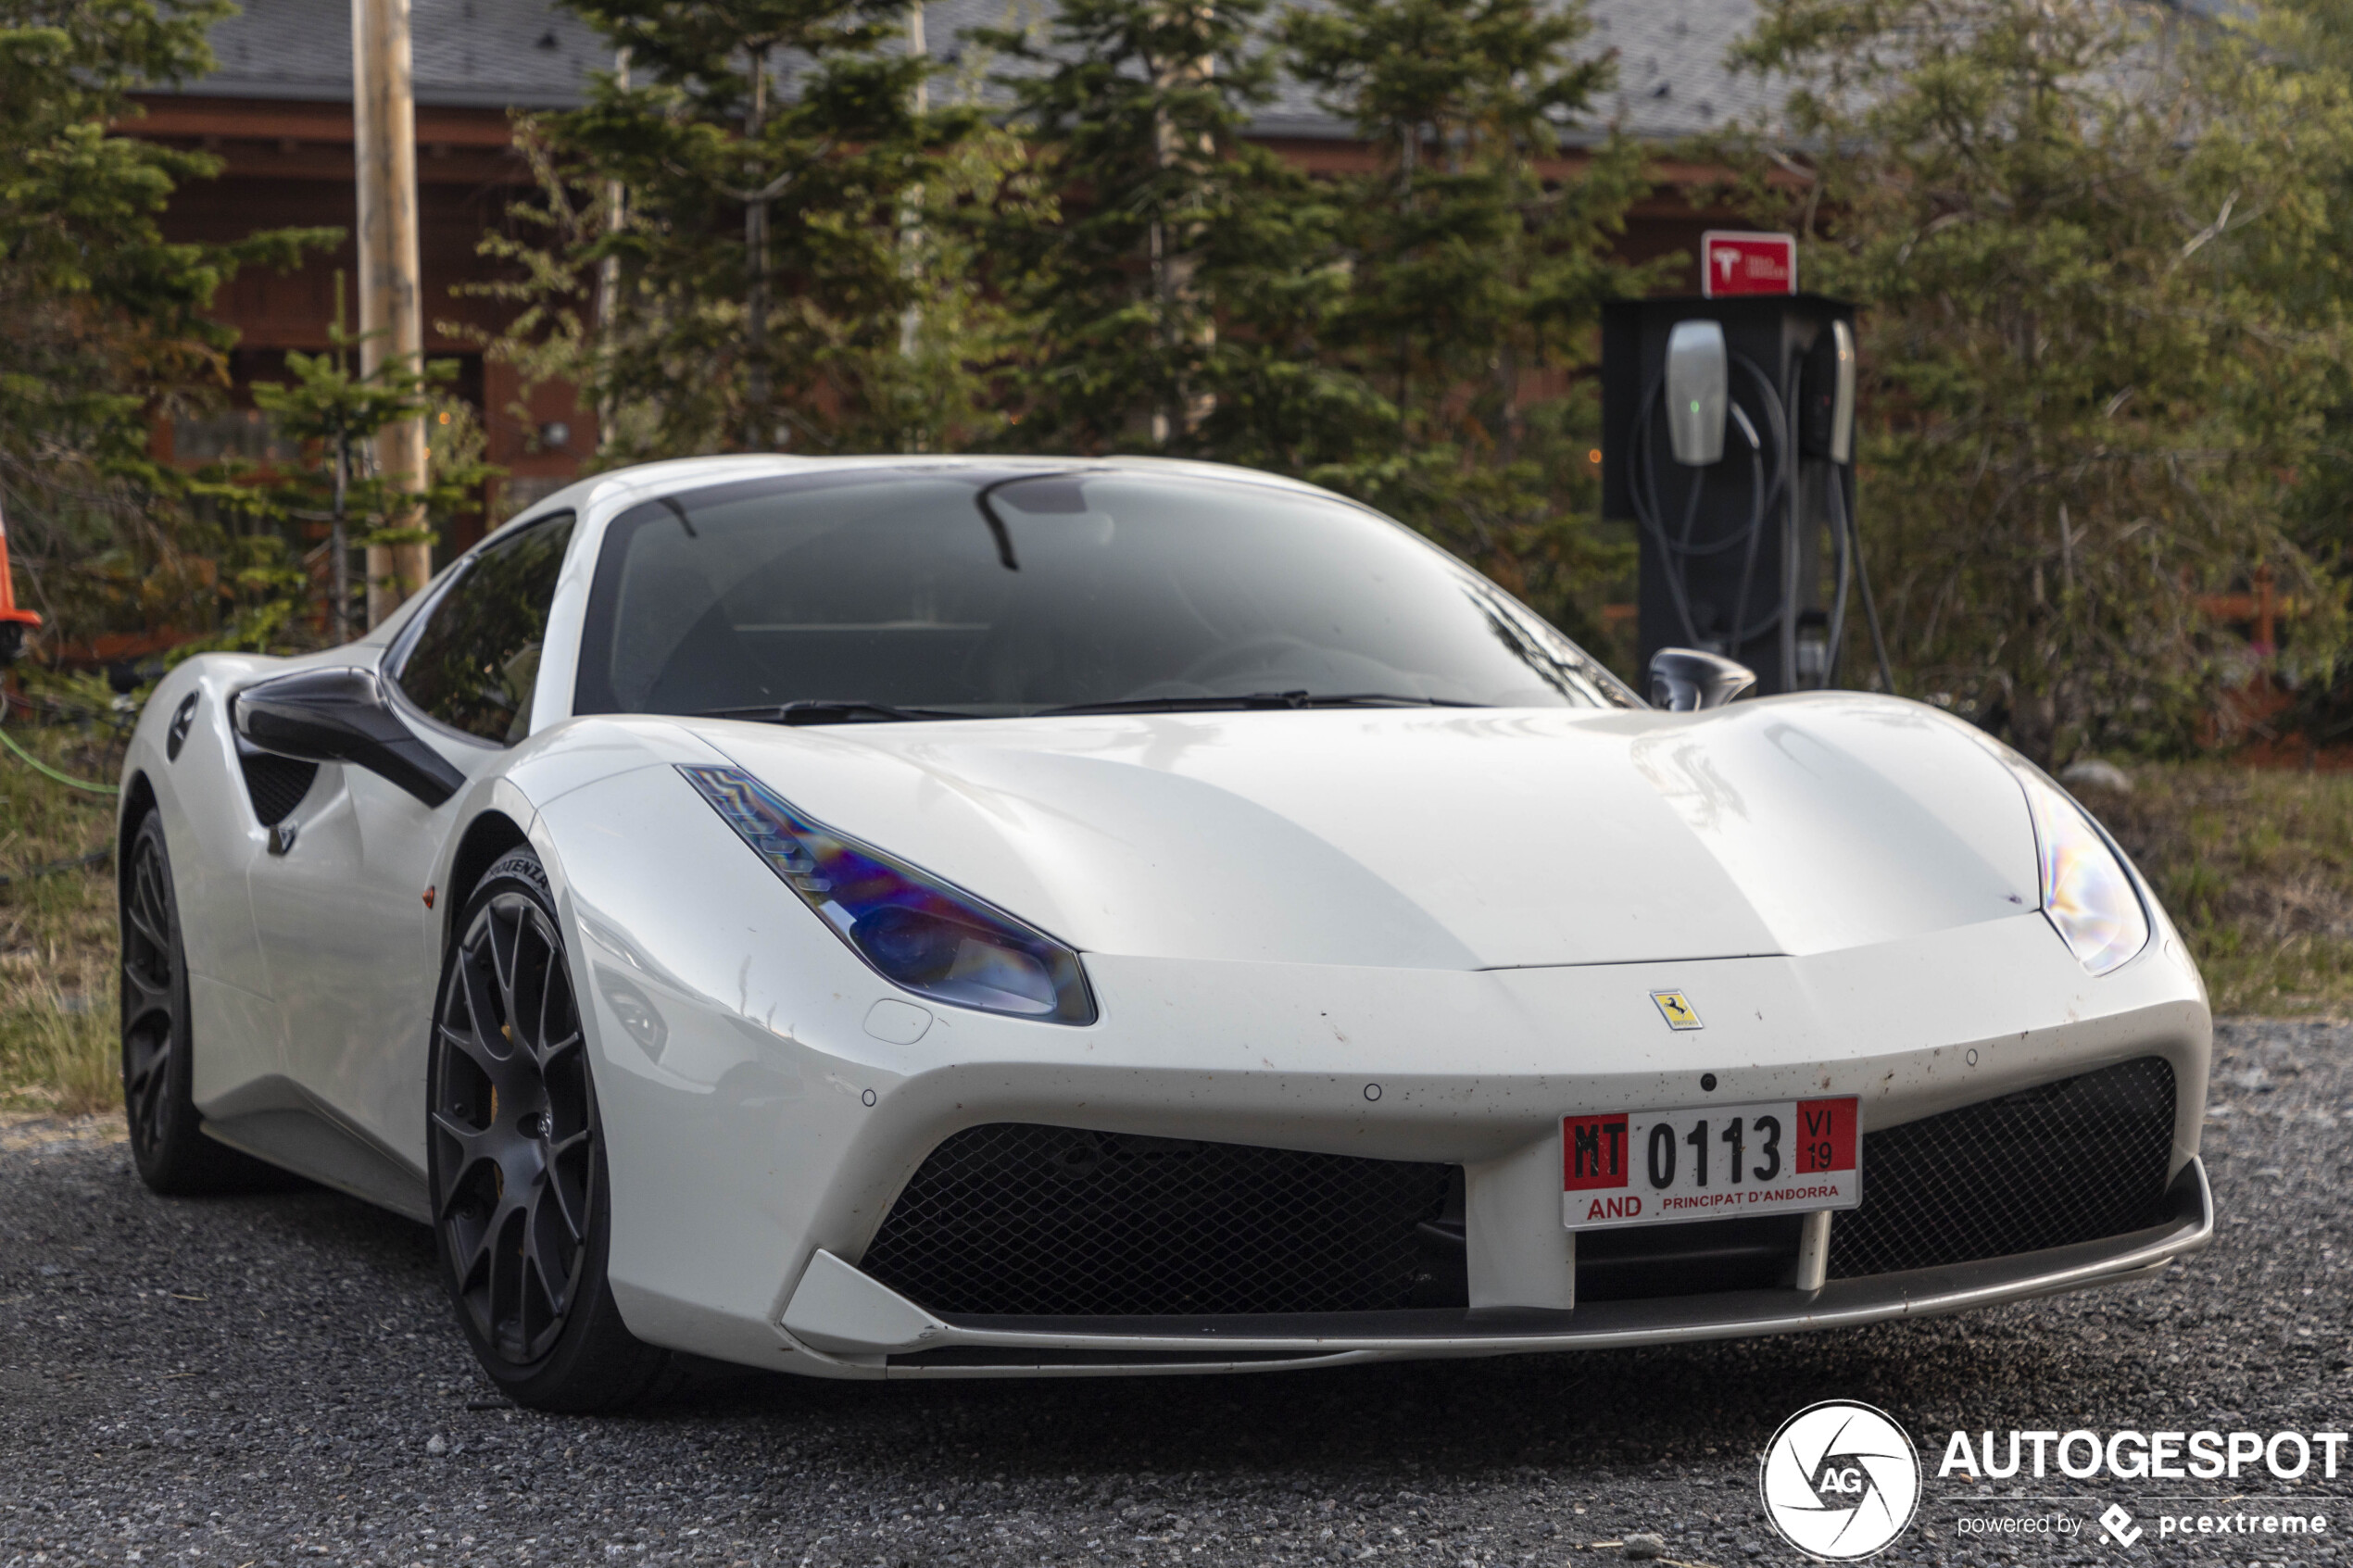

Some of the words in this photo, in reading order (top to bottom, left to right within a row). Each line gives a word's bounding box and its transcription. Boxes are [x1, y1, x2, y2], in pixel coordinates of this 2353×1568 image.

[1805, 1110, 1832, 1137] VI
[1575, 1122, 1627, 1179] MT
[1648, 1115, 1781, 1190] 0113
[1807, 1141, 1832, 1170] 19
[1587, 1196, 1642, 1221] AND
[1663, 1192, 1743, 1210] PRINCIPAT
[1749, 1185, 1839, 1203] D'ANDORRA
